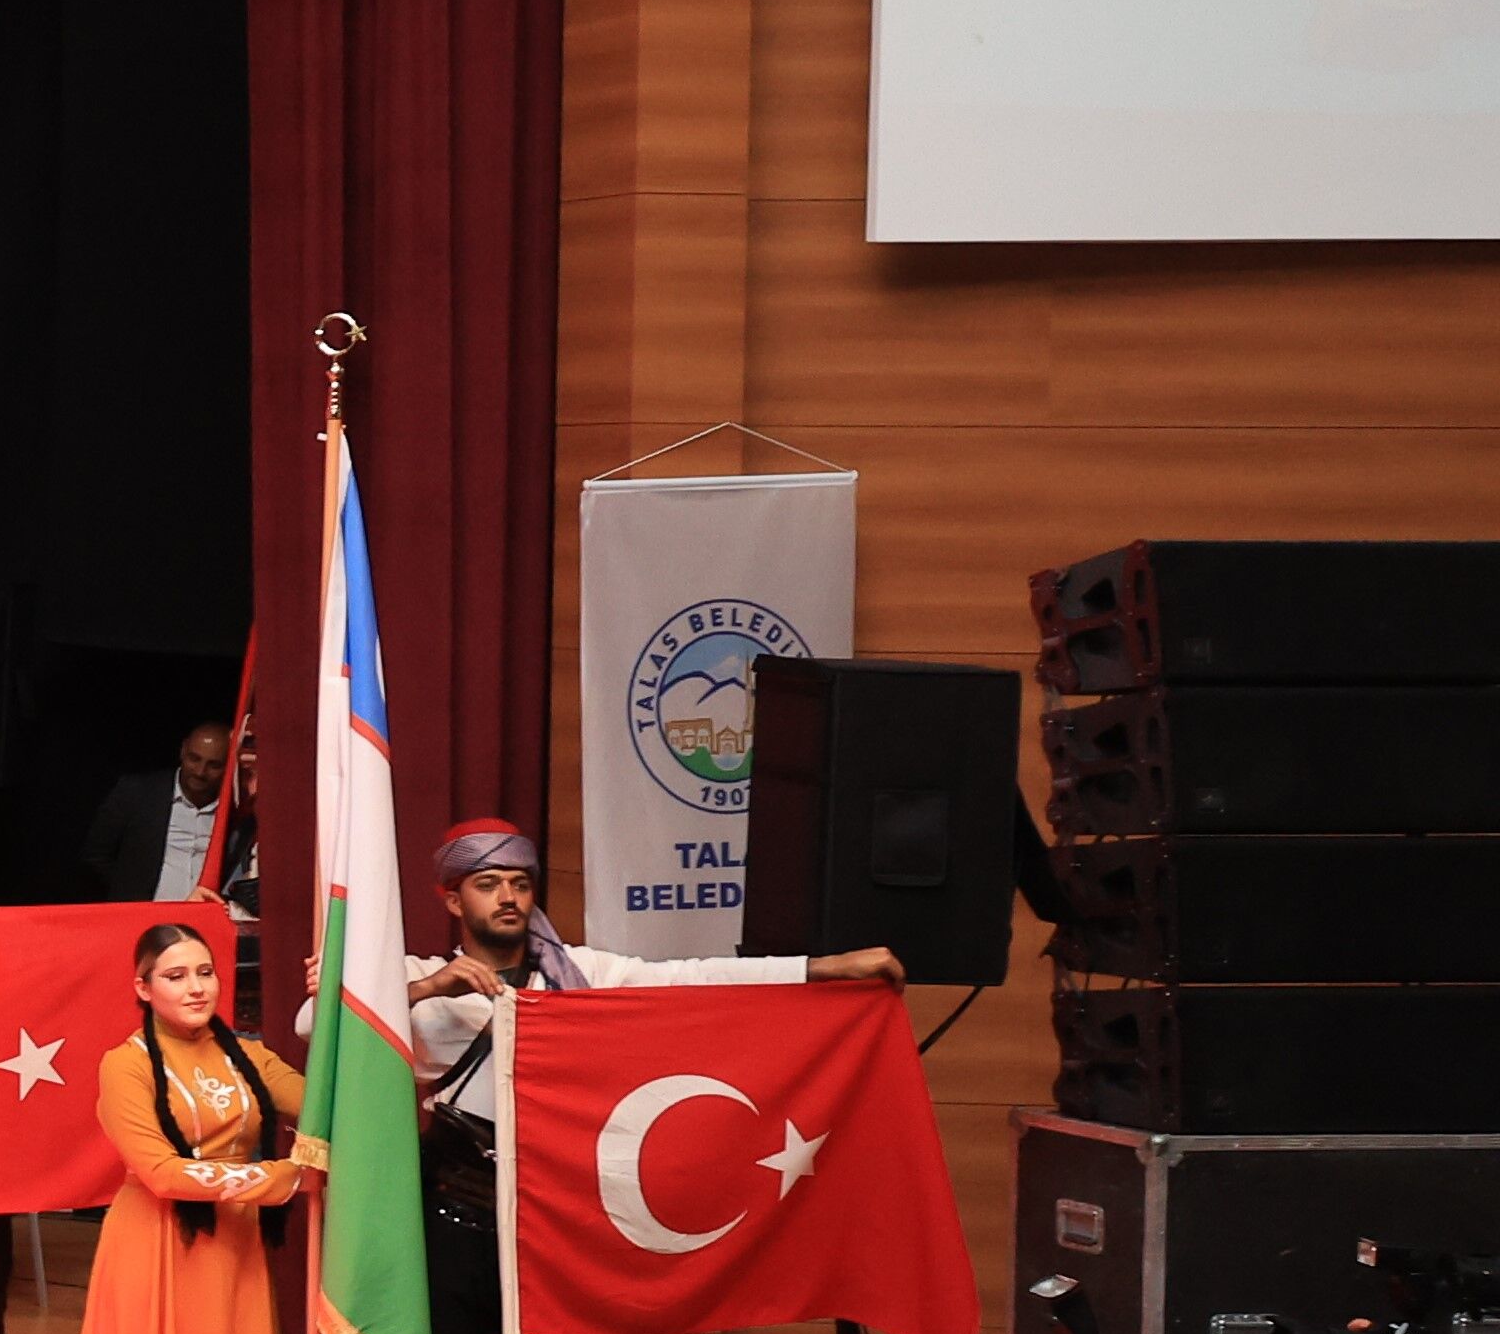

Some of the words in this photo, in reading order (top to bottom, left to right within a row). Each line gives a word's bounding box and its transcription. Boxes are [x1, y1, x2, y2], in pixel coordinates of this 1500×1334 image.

[636, 633, 678, 733] TALAS
[688, 607, 804, 659] BELEDİ
[675, 841, 747, 869] TAL
